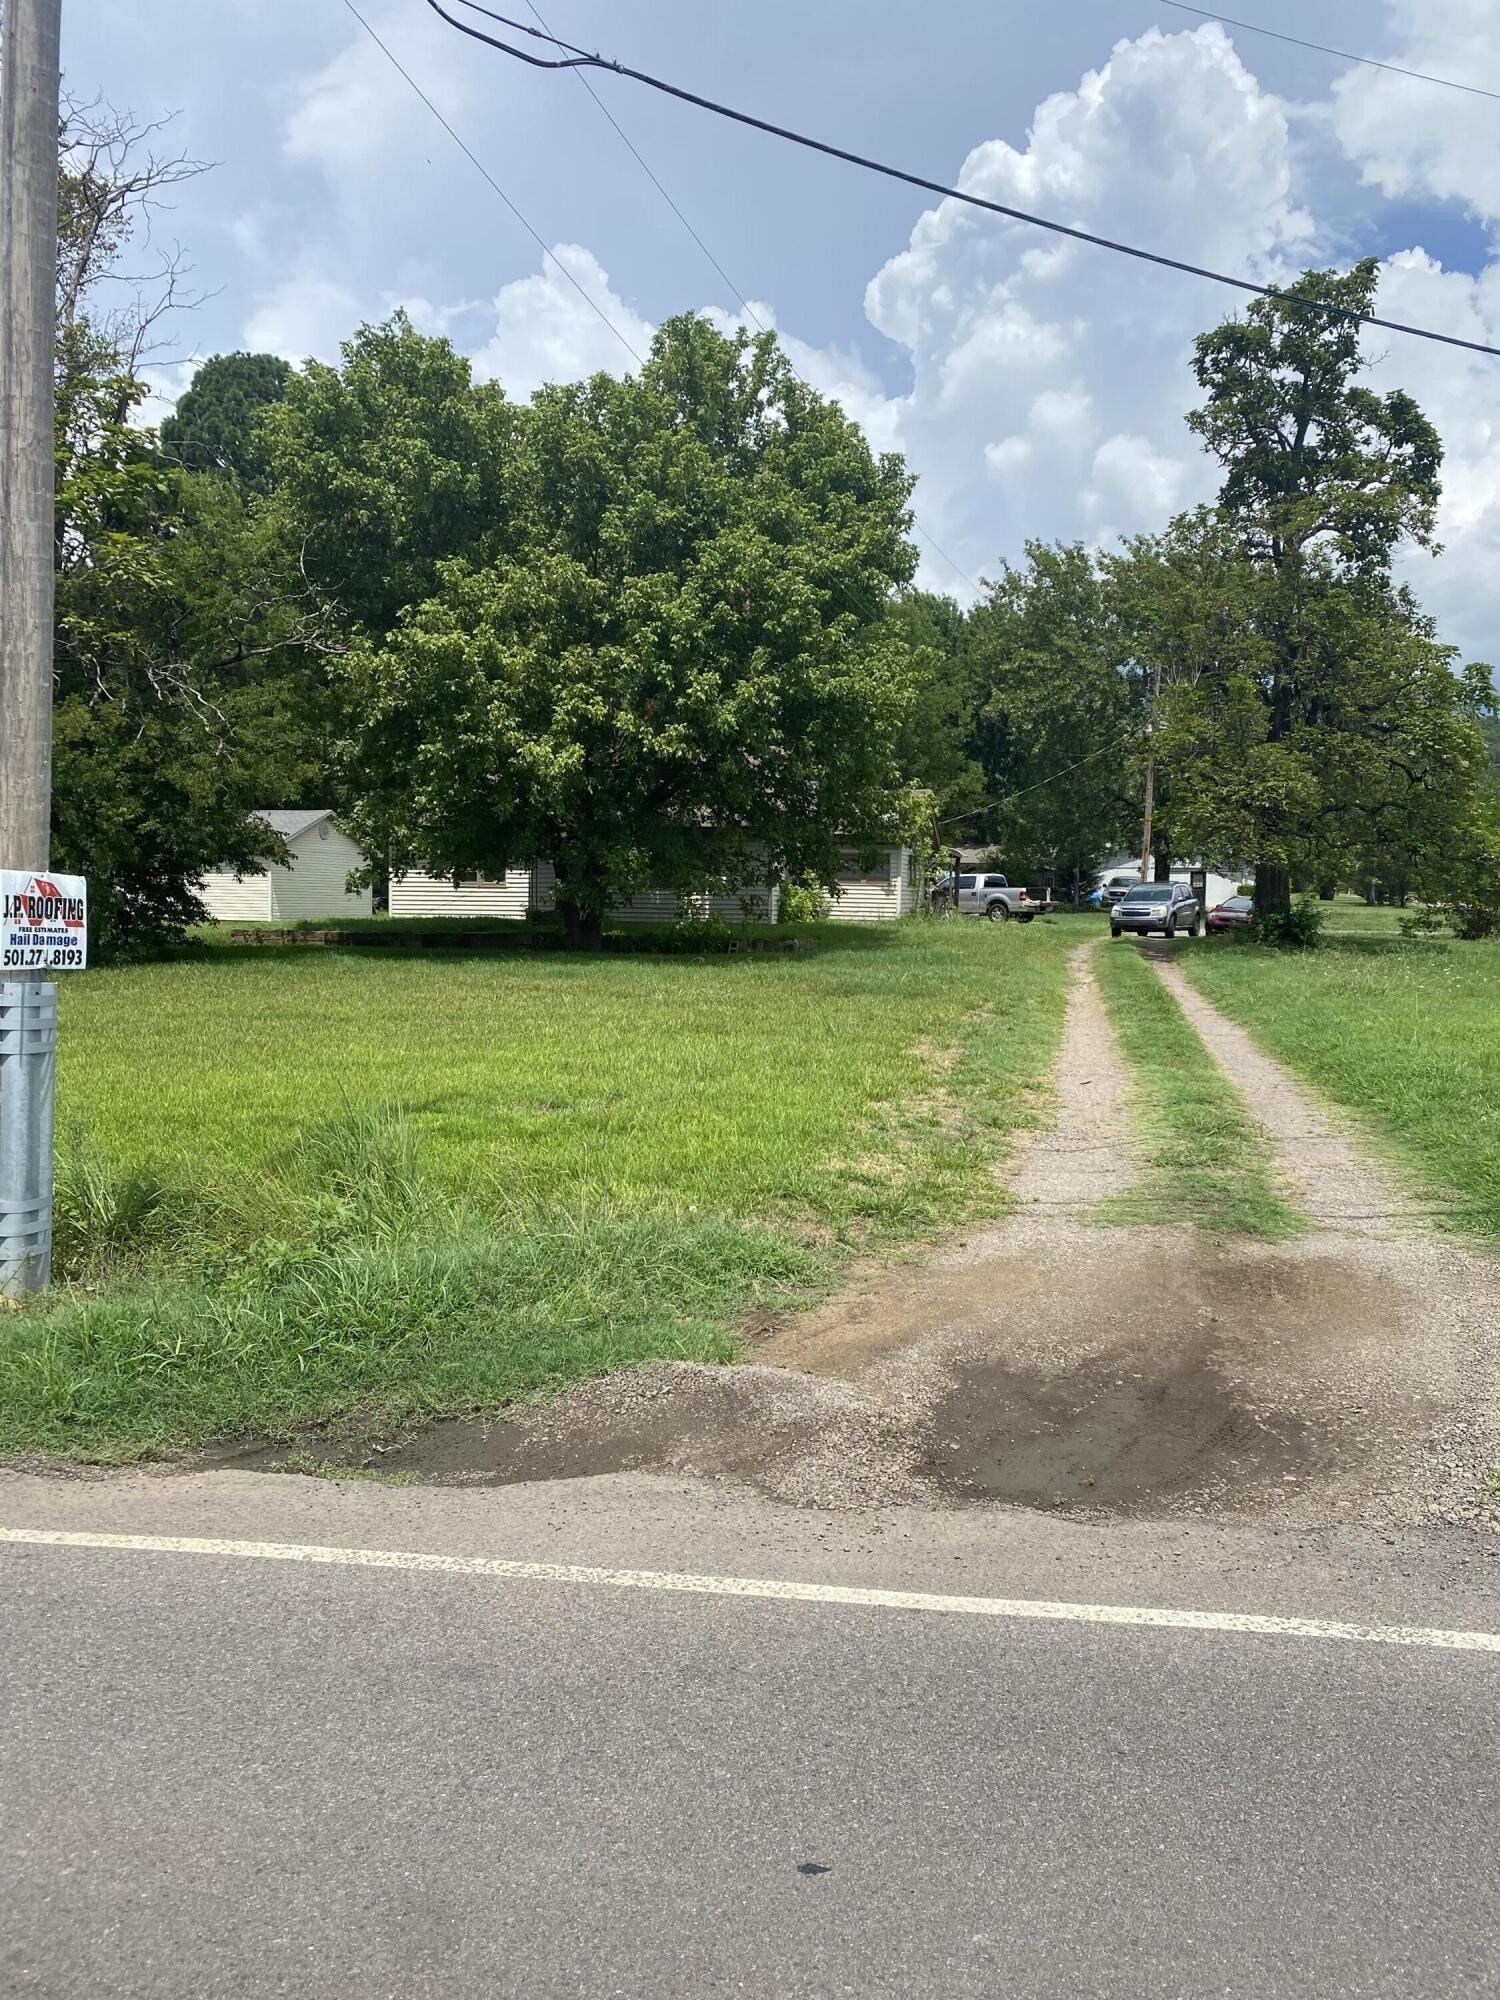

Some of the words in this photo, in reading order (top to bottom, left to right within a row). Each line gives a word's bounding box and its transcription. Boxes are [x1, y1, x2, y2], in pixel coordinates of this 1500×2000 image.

[28, 896, 84, 921] ROOFING
[10, 933, 31, 946] Hail
[32, 934, 78, 947] Damage
